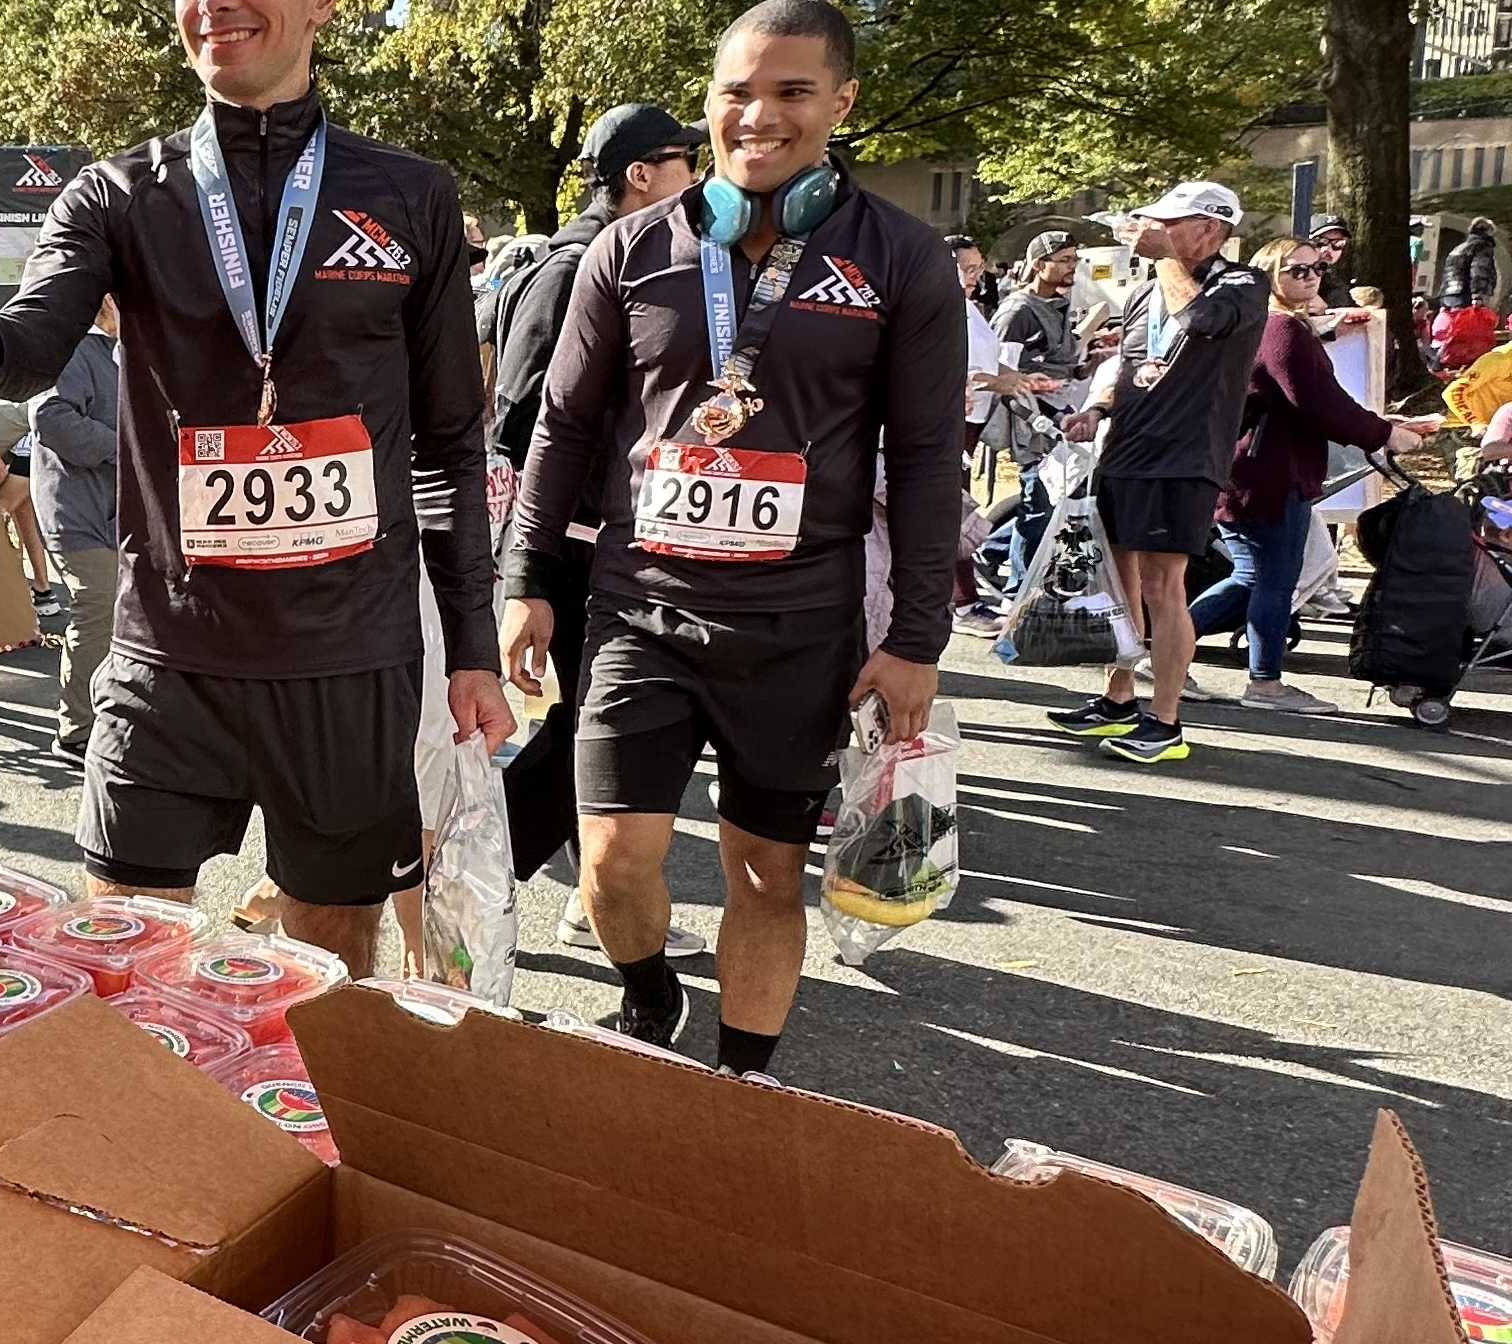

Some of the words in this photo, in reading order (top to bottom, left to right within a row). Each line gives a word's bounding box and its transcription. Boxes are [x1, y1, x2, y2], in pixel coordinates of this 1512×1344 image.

[208, 192, 245, 289] FINISHER
[280, 218, 298, 266] SEMPER
[361, 217, 391, 247] MCM
[385, 240, 412, 270] 26.2
[205, 460, 352, 526] 2933
[656, 477, 780, 531] 2916
[240, 538, 277, 547] recover
[291, 535, 324, 548] KPMG
[335, 525, 373, 537] ManTech
